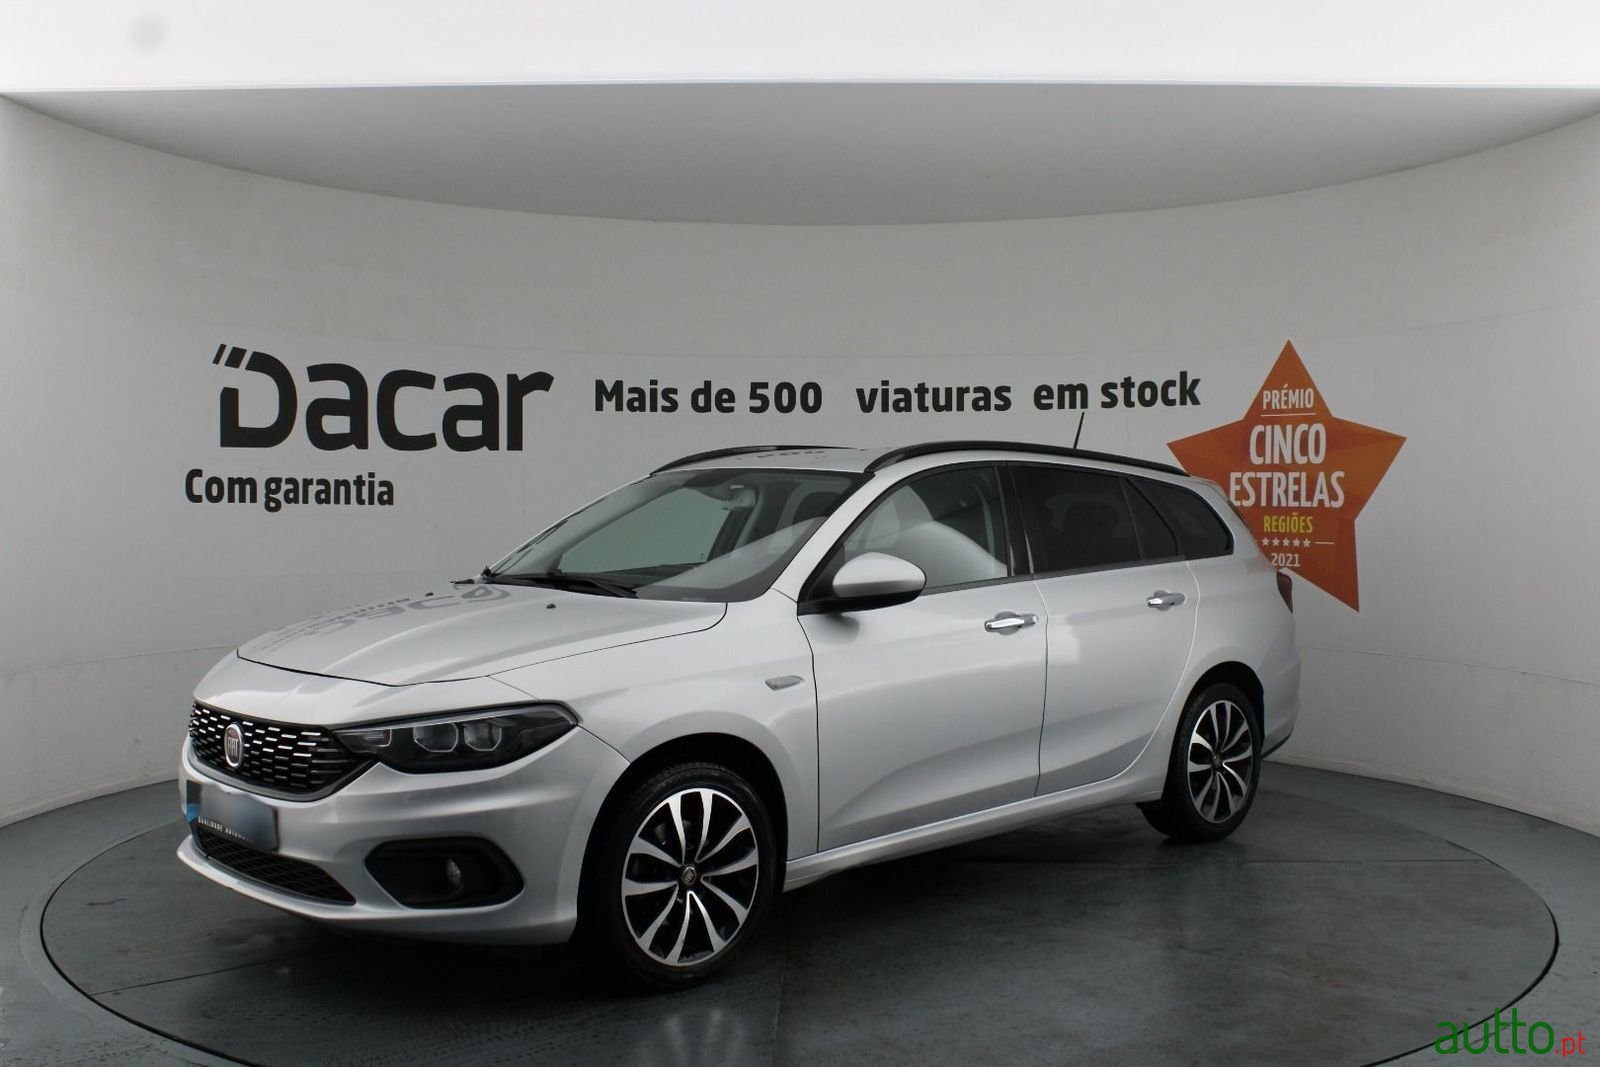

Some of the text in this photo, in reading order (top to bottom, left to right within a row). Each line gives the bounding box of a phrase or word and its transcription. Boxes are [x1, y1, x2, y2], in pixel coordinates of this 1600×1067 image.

[212, 343, 555, 452] Dacar
[594, 370, 1201, 414] Mais de 500 viaturas em stock
[1262, 384, 1315, 410] PRÉMIO
[1250, 422, 1327, 465] CINCO
[185, 468, 394, 513] Com garantia
[1229, 470, 1345, 508] ESTRELAS
[1263, 512, 1314, 533] REGIÕES
[1271, 552, 1301, 567] 2021
